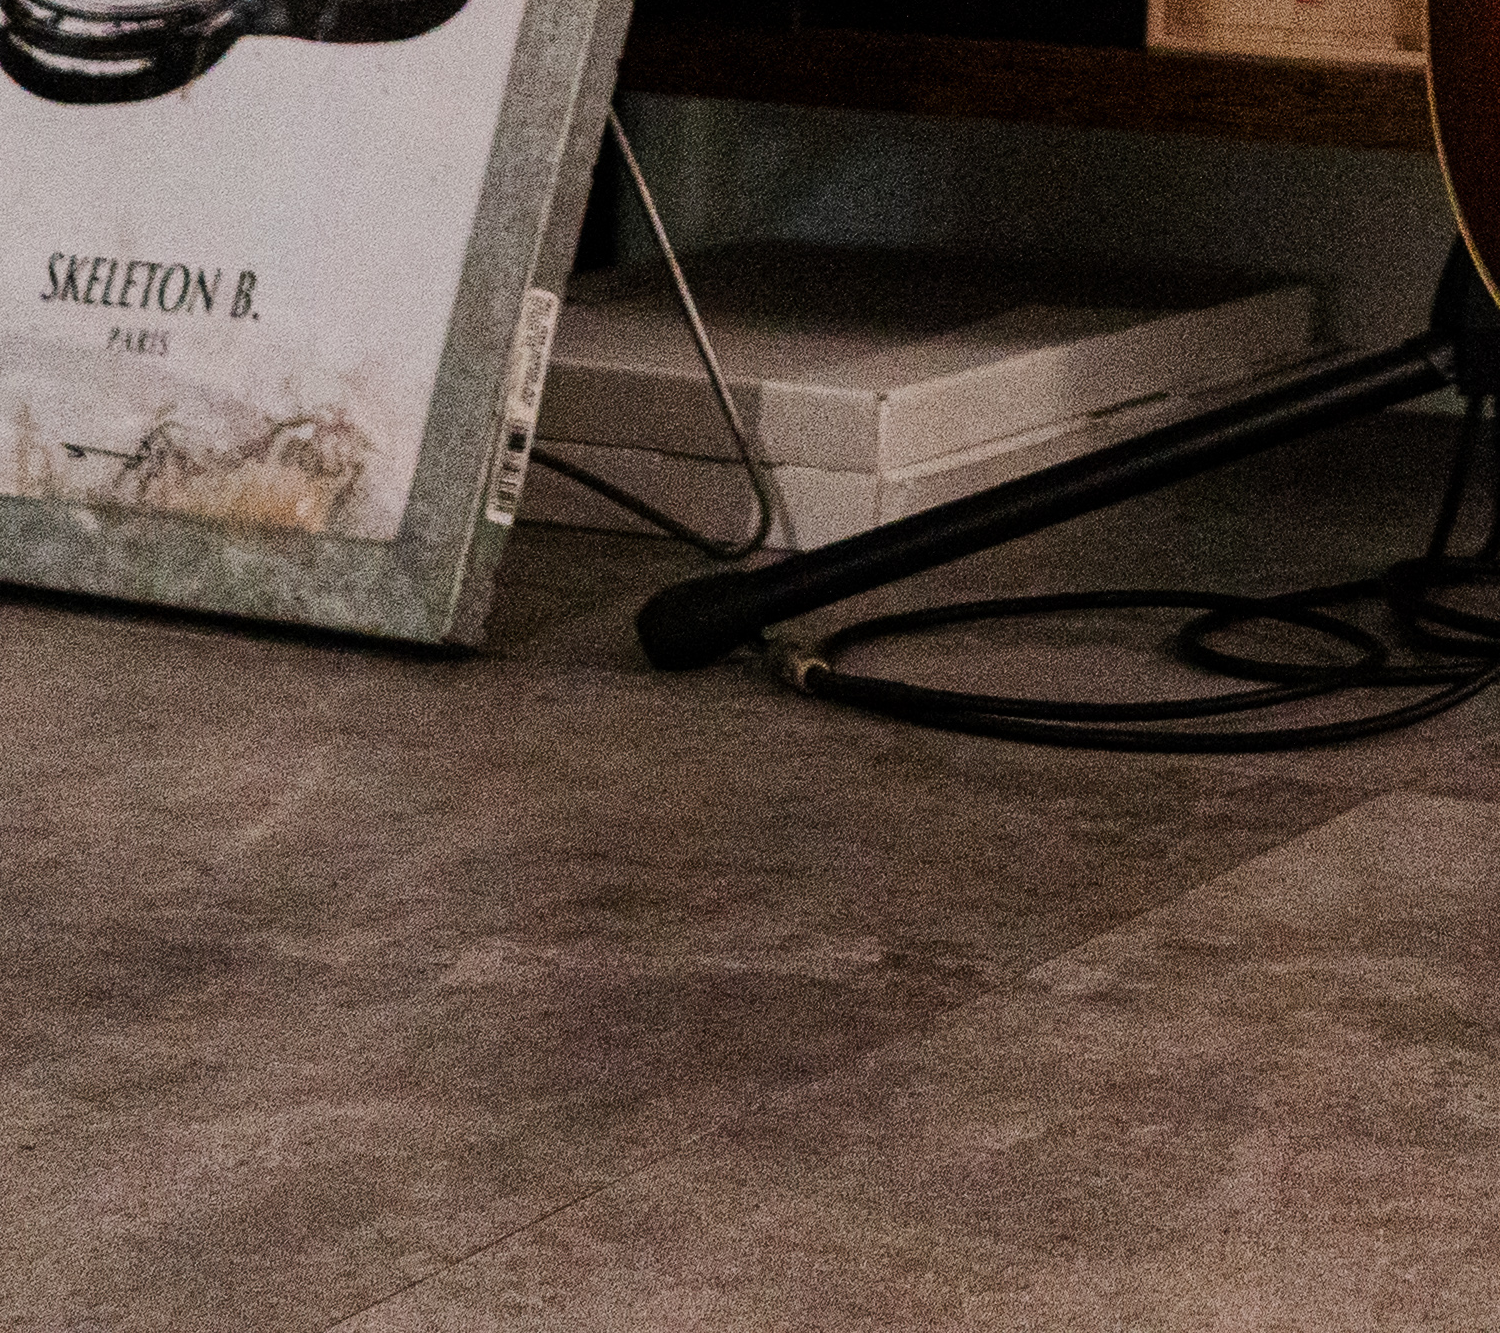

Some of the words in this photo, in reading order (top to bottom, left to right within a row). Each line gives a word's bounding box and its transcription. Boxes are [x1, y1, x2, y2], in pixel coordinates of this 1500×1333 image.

[40, 251, 222, 316] SKELETON
[229, 268, 260, 322] B.
[107, 325, 171, 358] PARIS
